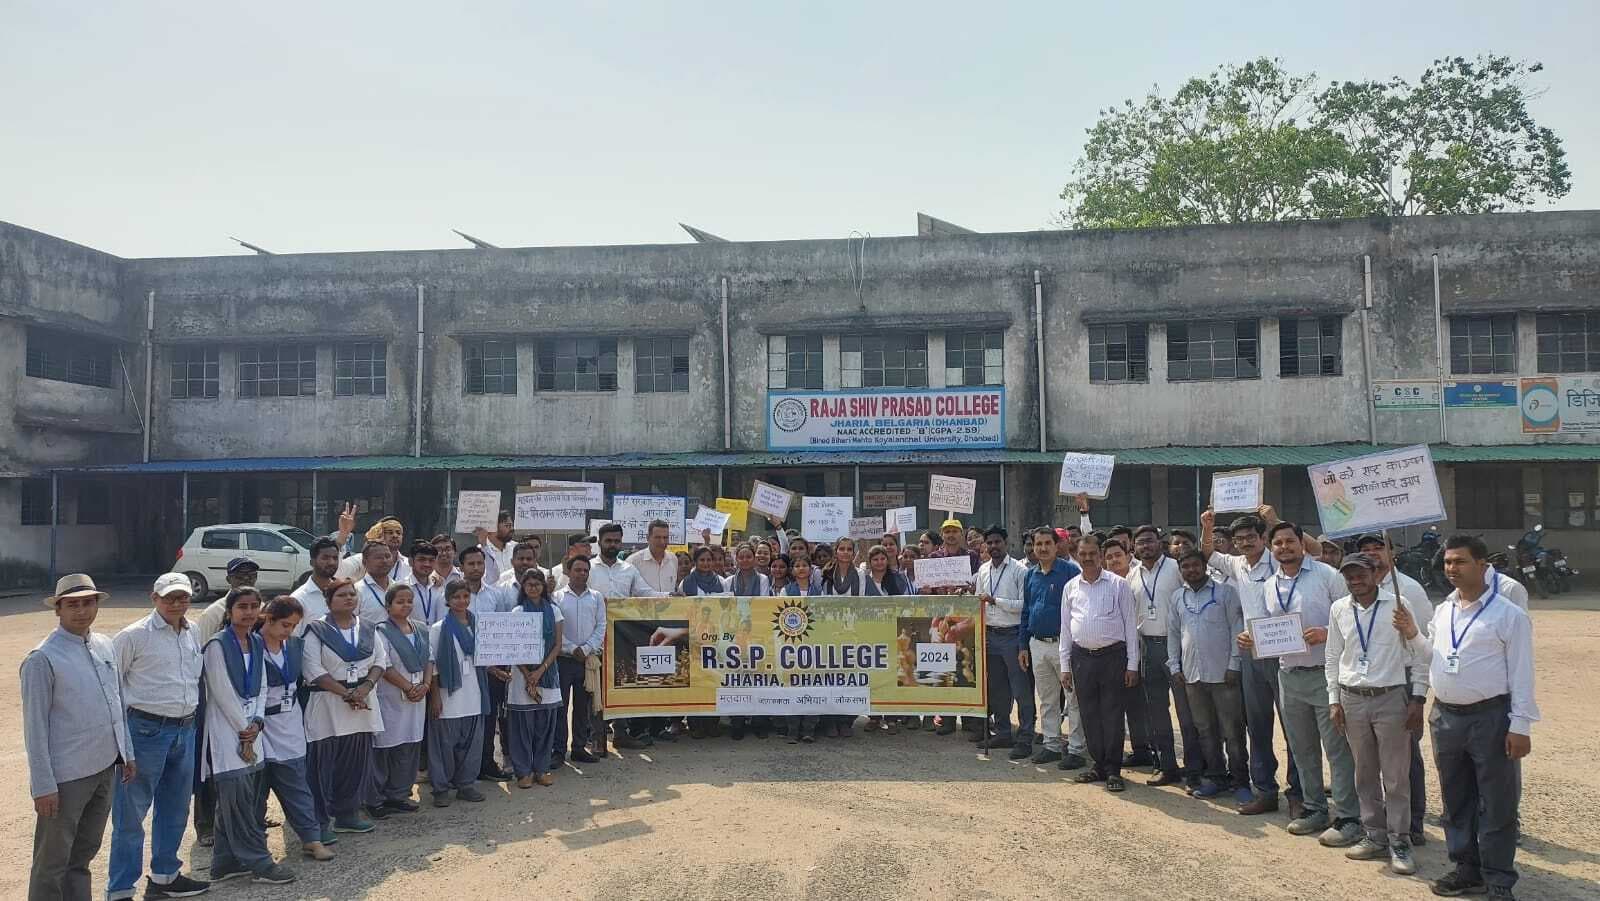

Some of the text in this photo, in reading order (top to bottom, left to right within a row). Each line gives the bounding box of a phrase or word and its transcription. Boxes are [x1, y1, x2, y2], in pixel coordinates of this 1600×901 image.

[810, 398, 847, 417] RAJA
[850, 397, 878, 417] SHIV
[881, 396, 931, 417] PRASAD
[936, 394, 999, 416] COLLEGE
[875, 418, 930, 428] BELGARIA
[931, 417, 988, 427] (DHANBAD)
[837, 428, 857, 436] NAAC
[1374, 493, 1409, 507] मतदान
[701, 632, 735, 642] Org. By
[640, 654, 672, 670] चुनाव
[702, 645, 887, 670] R.S.P. COLLEGE
[920, 652, 950, 663] 2024
[721, 673, 869, 688] JHARIA, DHANBAD
[795, 693, 827, 705] अभियान
